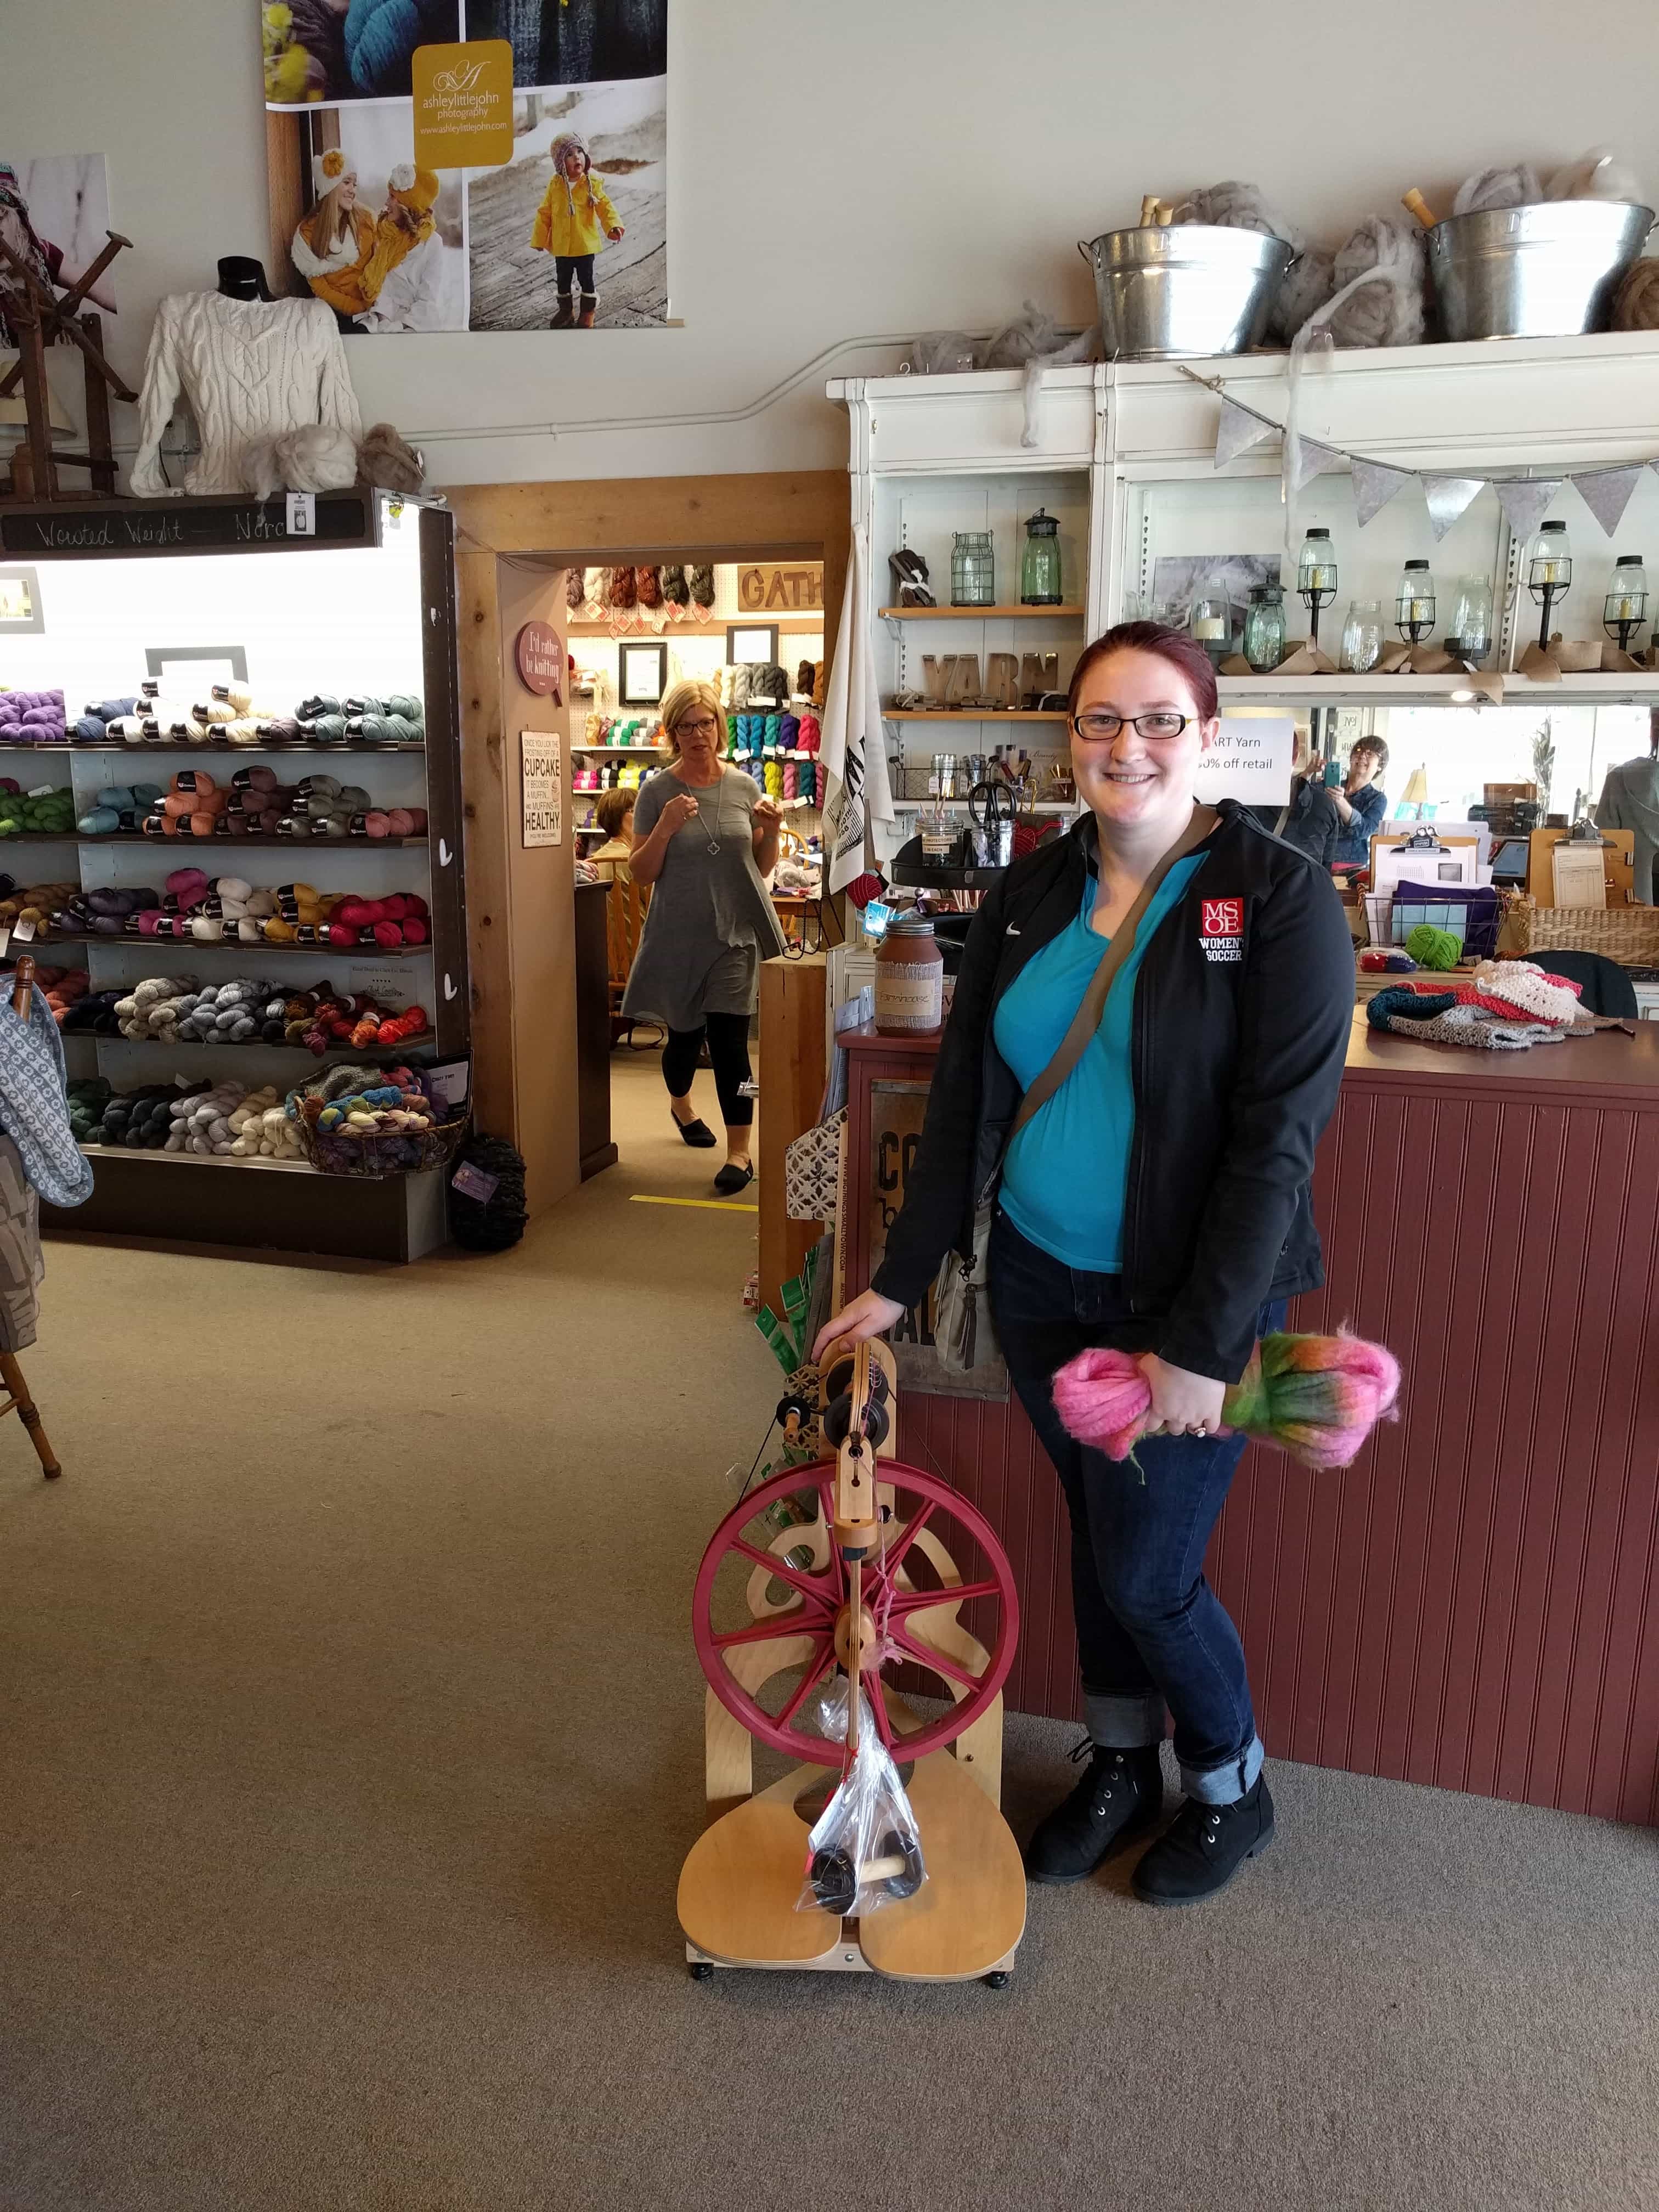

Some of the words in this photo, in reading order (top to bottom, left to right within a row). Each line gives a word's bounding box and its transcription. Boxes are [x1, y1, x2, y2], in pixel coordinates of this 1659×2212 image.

[423, 90, 500, 110] ashleylittlejohn
[437, 105, 488, 121] photography
[420, 121, 507, 134] www.ashleylittlejohn.com
[124, 516, 185, 544] Weight
[529, 631, 540, 653] I'd
[541, 638, 559, 656] rather
[526, 653, 534, 674] be
[535, 654, 559, 684] knitting
[921, 652, 1058, 710] YARN
[1235, 737, 1260, 747] Yarn
[524, 758, 560, 777] CUPCAKE
[1223, 758, 1239, 769] off
[1243, 759, 1272, 769] retail
[532, 802, 554, 810] MUFFINS
[526, 812, 560, 831] HEALTHY.
[1206, 950, 1243, 961] SOCCER
